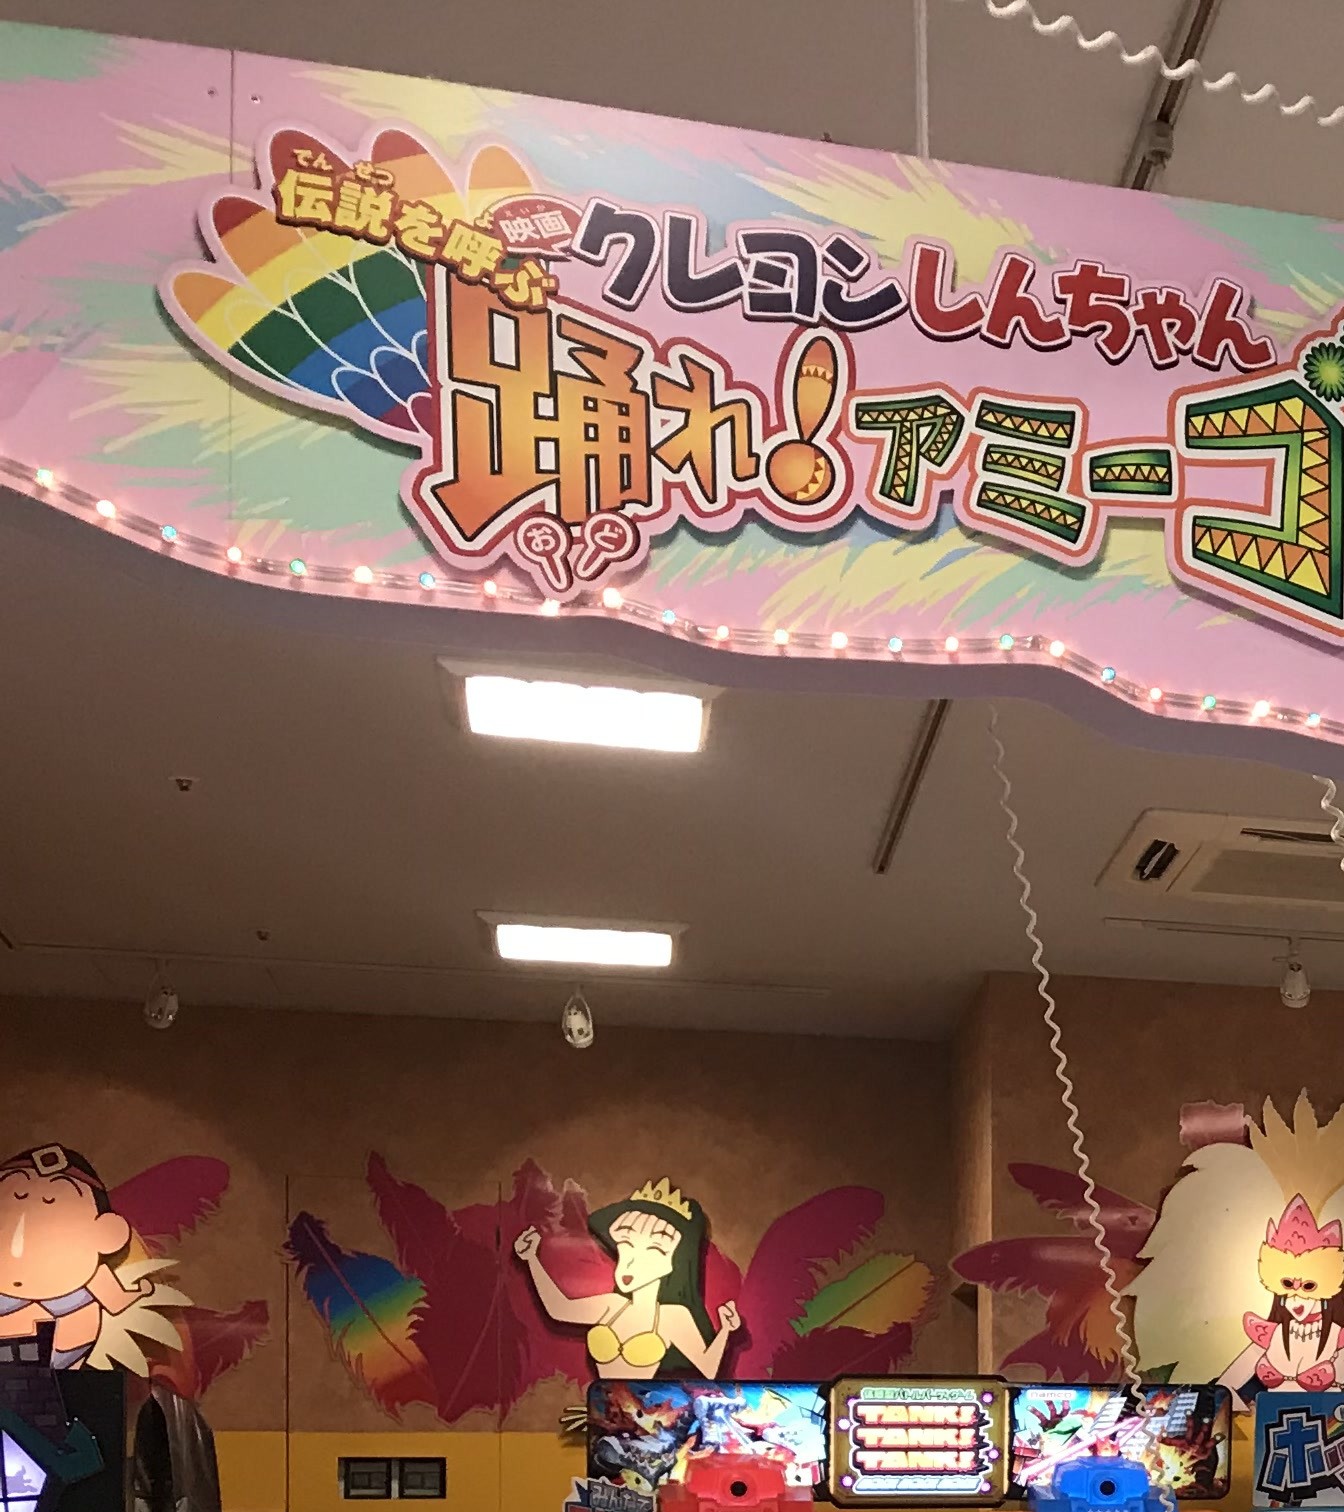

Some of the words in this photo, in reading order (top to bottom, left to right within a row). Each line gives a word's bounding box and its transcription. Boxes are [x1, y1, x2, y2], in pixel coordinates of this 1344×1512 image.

[499, 207, 571, 246] 映画
[572, 199, 1274, 368] クレヨンしんちゃん
[1028, 1389, 1074, 1400] namco
